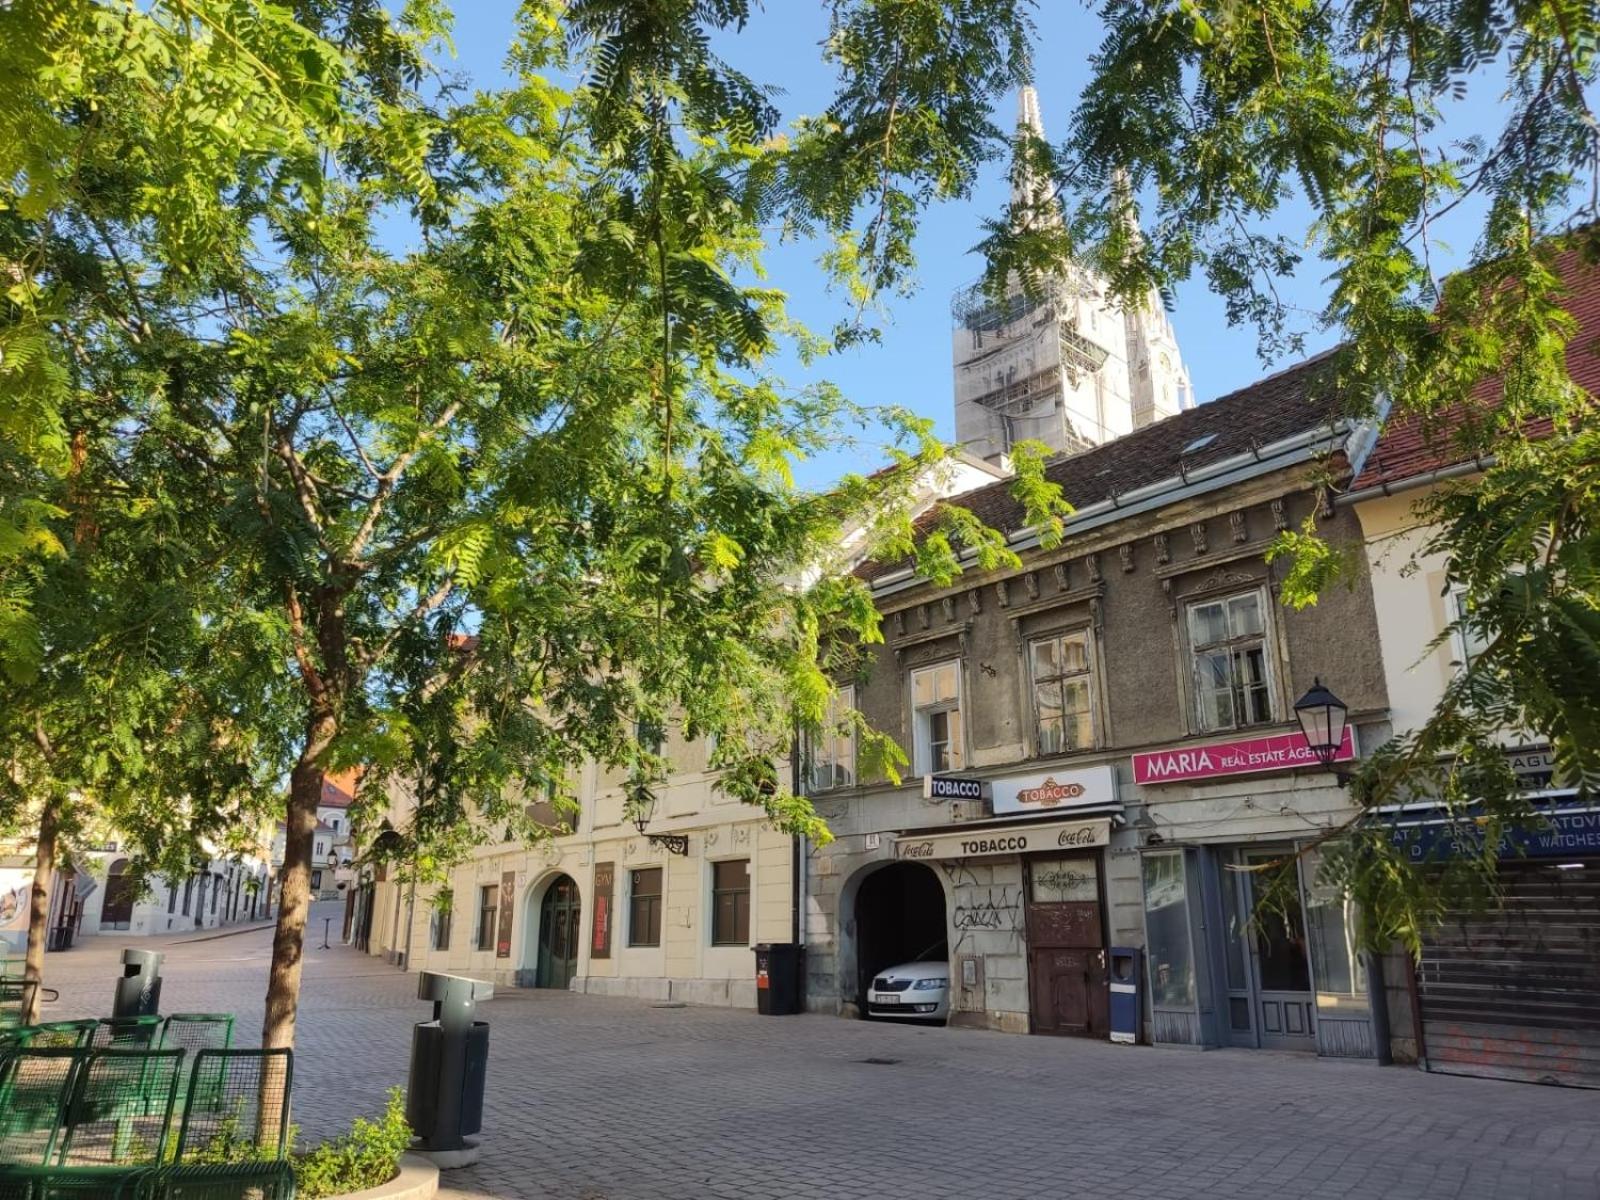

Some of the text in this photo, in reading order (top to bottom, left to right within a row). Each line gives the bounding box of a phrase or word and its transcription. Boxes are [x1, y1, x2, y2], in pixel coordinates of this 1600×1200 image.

[1147, 750, 1213, 778] MARIA
[1221, 755, 1246, 768] REAL
[1249, 751, 1285, 765] ESTATE
[932, 780, 981, 797] TOBACCO
[1022, 785, 1080, 801] TOBACCO
[961, 836, 1027, 854] TOBACCO
